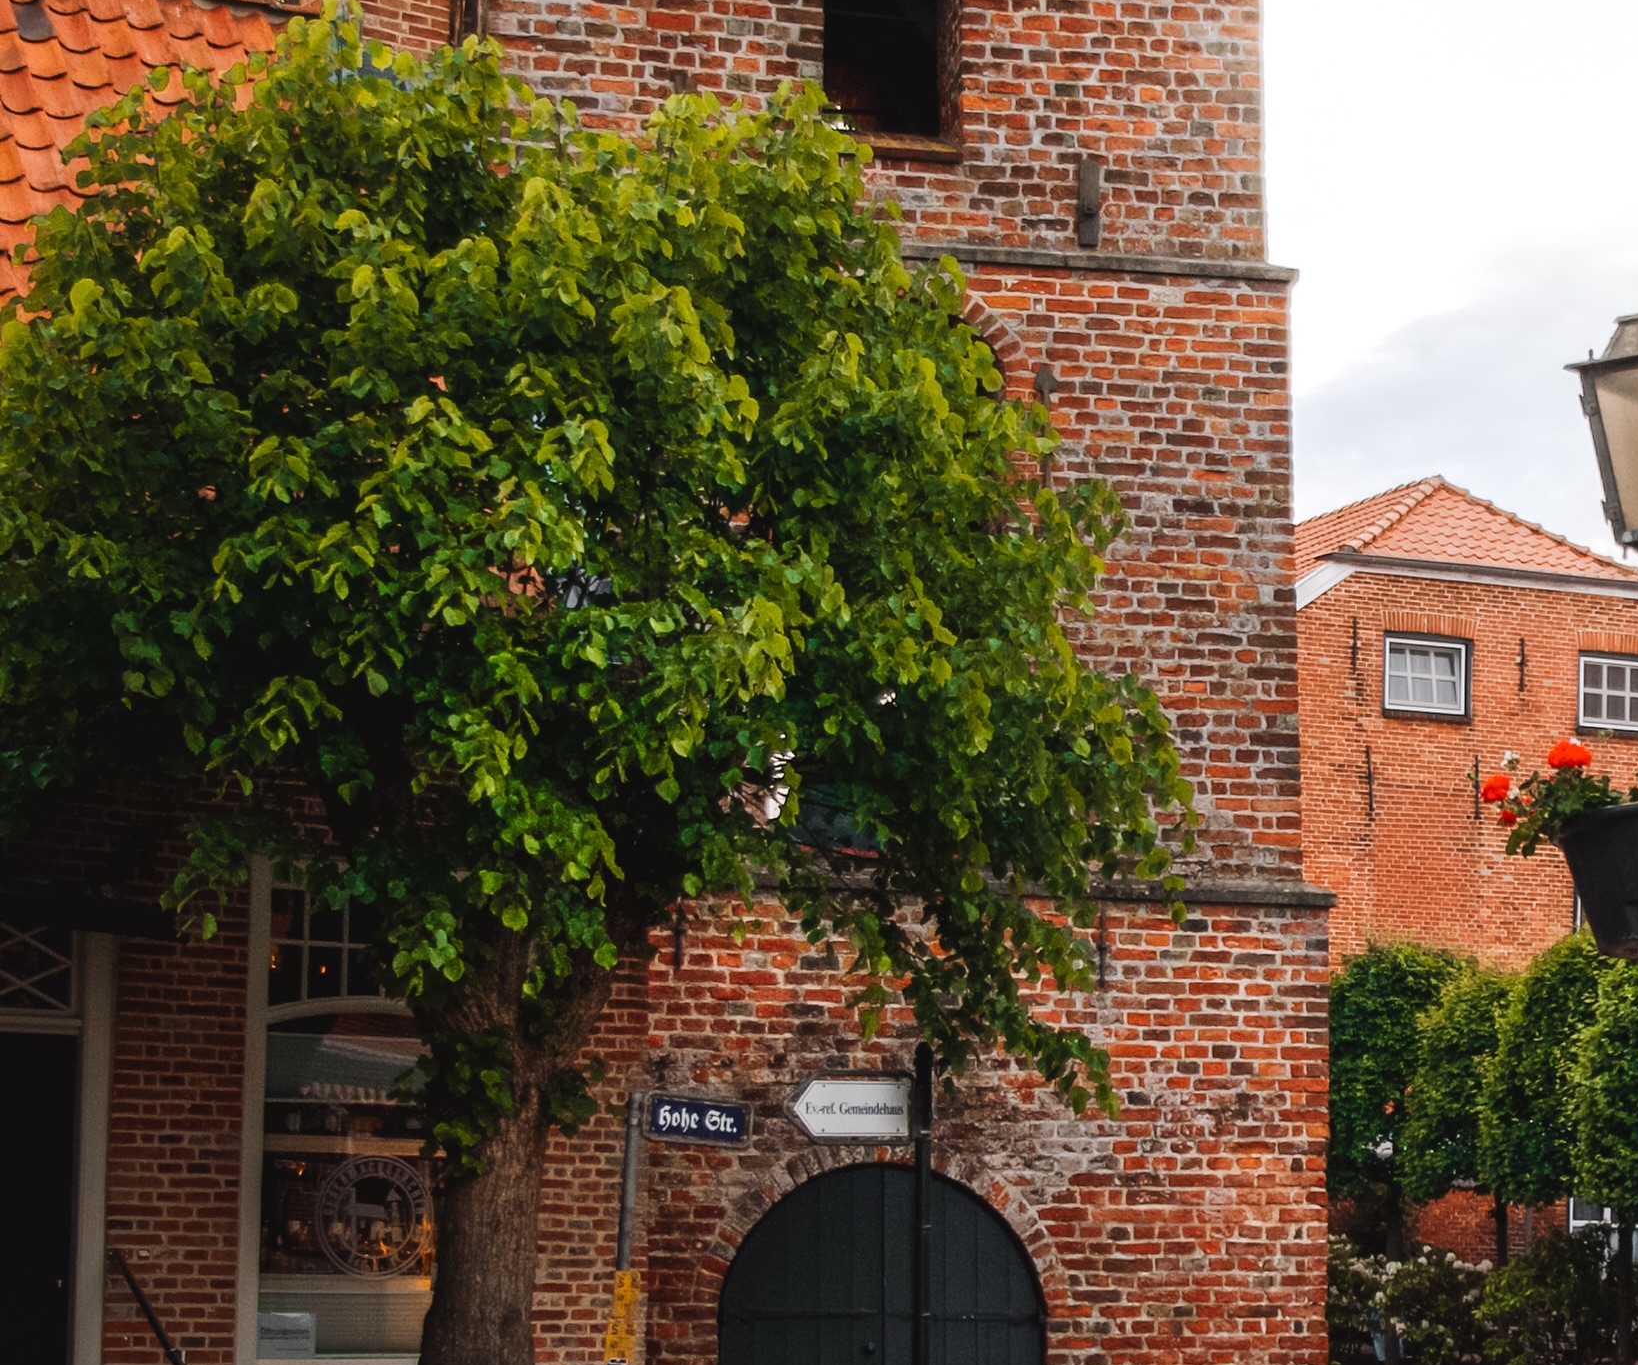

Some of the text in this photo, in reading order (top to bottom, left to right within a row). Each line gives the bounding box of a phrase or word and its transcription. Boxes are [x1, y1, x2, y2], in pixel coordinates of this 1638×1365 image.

[839, 1102, 905, 1115] Gemeindehaus
[658, 1105, 737, 1133] Hohe Str.
